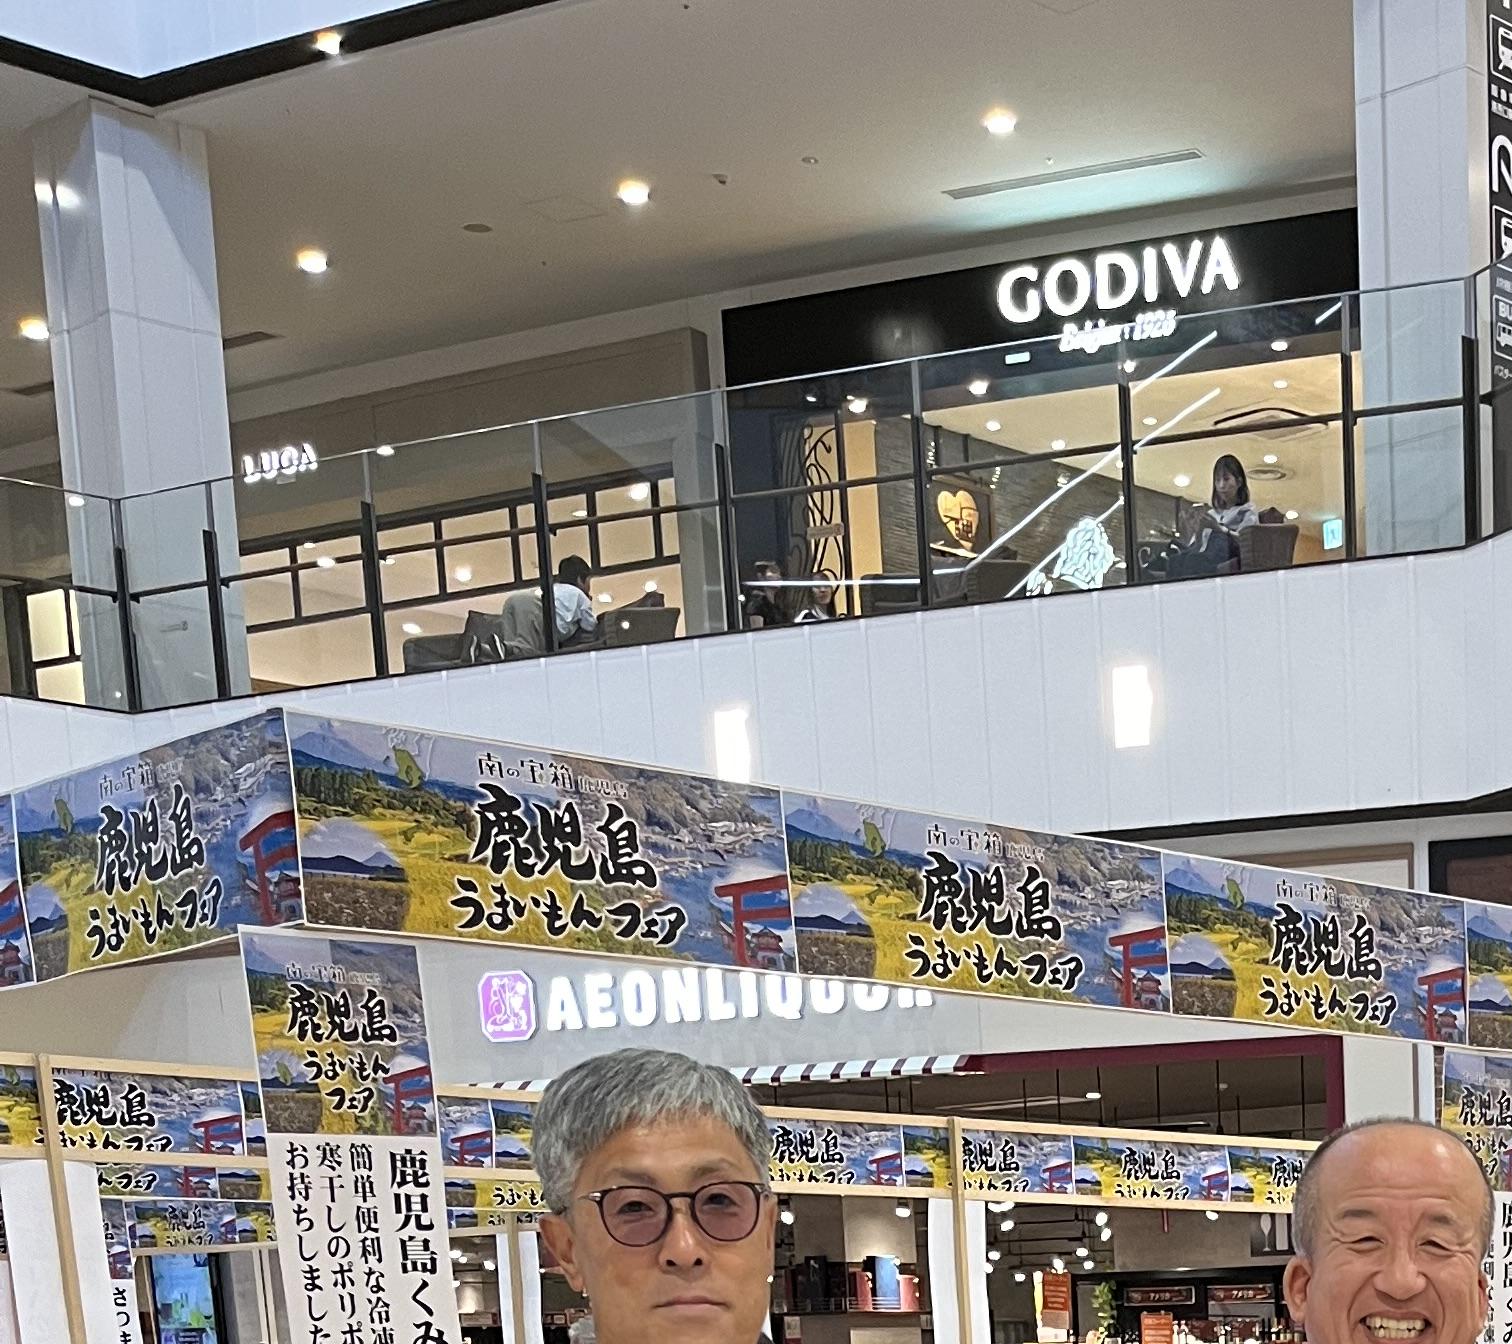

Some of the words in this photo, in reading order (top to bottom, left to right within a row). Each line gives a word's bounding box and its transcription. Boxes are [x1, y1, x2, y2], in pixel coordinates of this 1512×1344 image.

[997, 235, 1240, 323] GODIVA
[479, 752, 574, 791] 南の宝箱
[95, 783, 206, 896] 鹿児島
[471, 782, 658, 889] 鹿児島
[86, 877, 224, 959] うまいもんフェア
[449, 877, 687, 946] うまいもんフェア
[918, 850, 1062, 942] 鹿児島
[903, 933, 1085, 992] うまいもんフェア
[1270, 902, 1384, 982] 鹿児島
[286, 982, 399, 1044] 鹿児島
[1258, 977, 1398, 1027] うまいもんフェア
[303, 1049, 391, 1083] うまいもん
[324, 1086, 375, 1113] フェア
[771, 1125, 845, 1166] 鹿児島
[1121, 1145, 1182, 1182] 鹿児島
